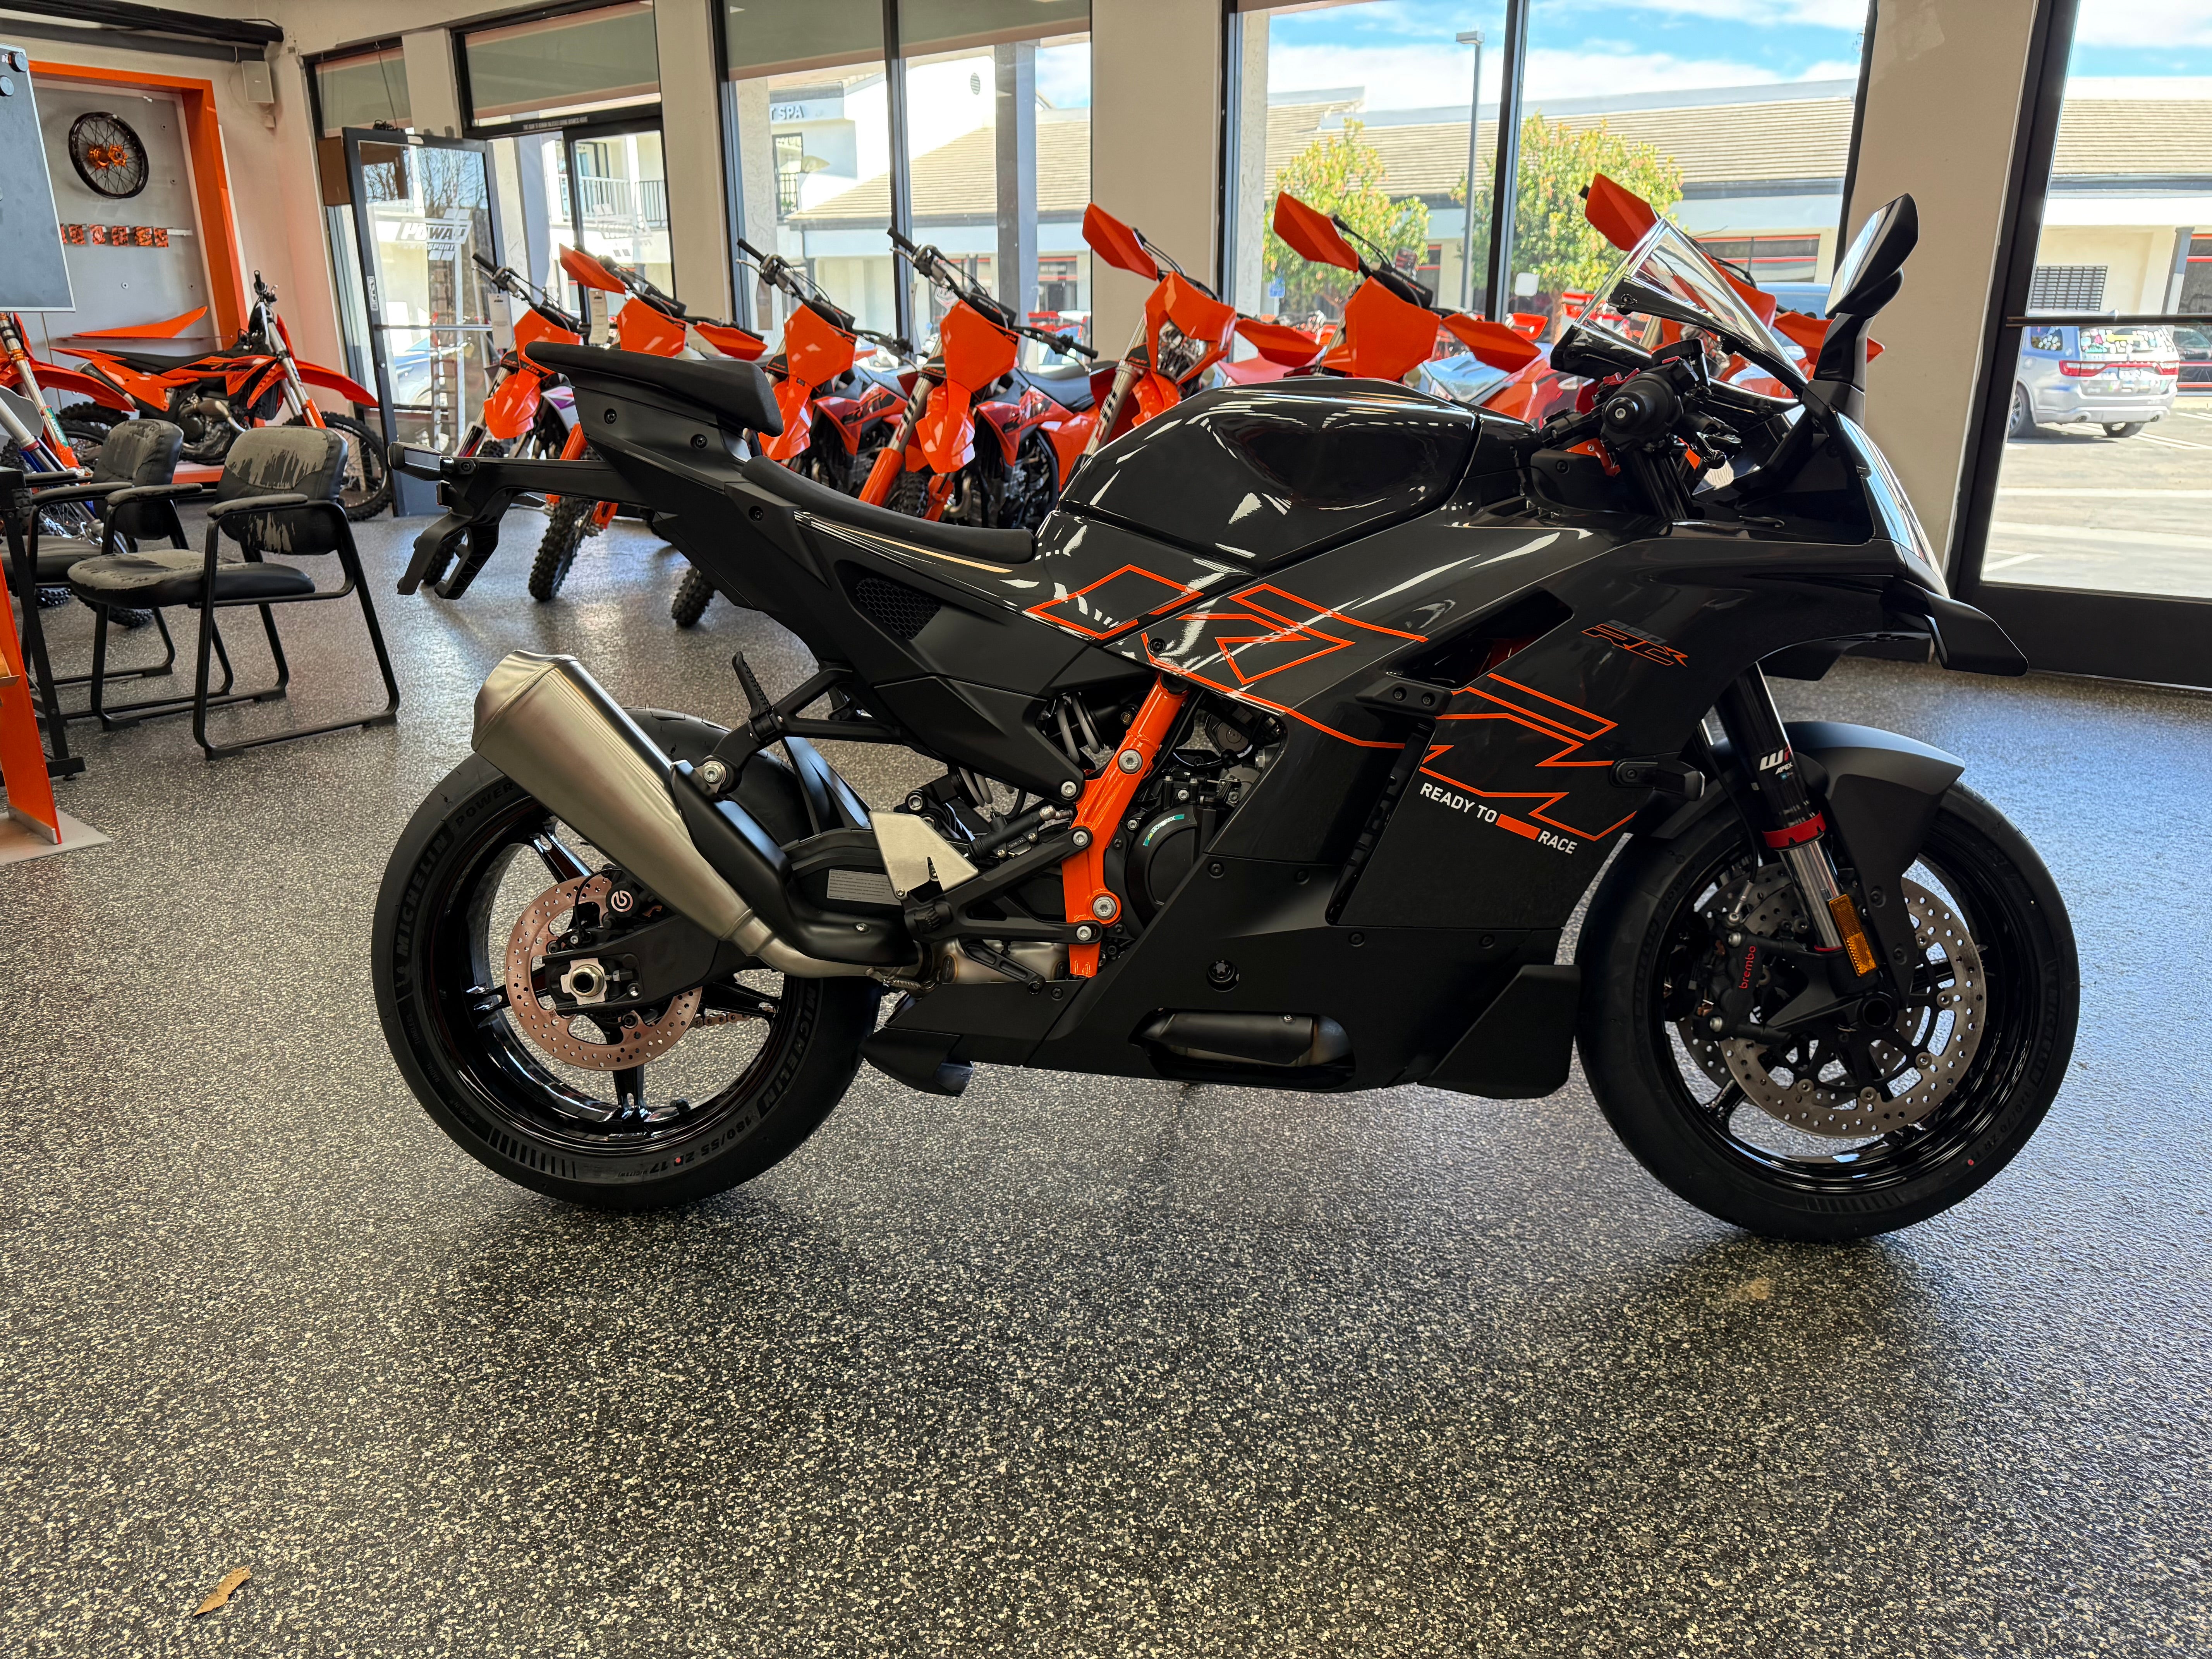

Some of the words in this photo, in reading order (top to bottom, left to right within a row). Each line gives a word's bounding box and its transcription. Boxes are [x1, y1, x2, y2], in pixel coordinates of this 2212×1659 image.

[778, 105, 804, 120] SPA
[1775, 762, 1794, 775] APEX
[455, 782, 514, 827] POWER
[1149, 816, 1176, 834] MOTOREX
[1420, 782, 1475, 814] READY
[1476, 804, 1498, 823] TO
[1538, 831, 1578, 855] RACE
[396, 833, 449, 957] MICHELIN
[1738, 946, 1757, 989] brembo
[762, 985, 816, 1108] MICHELIN
[701, 1116, 752, 1156] 180/55
[649, 1160, 668, 1174] 17
